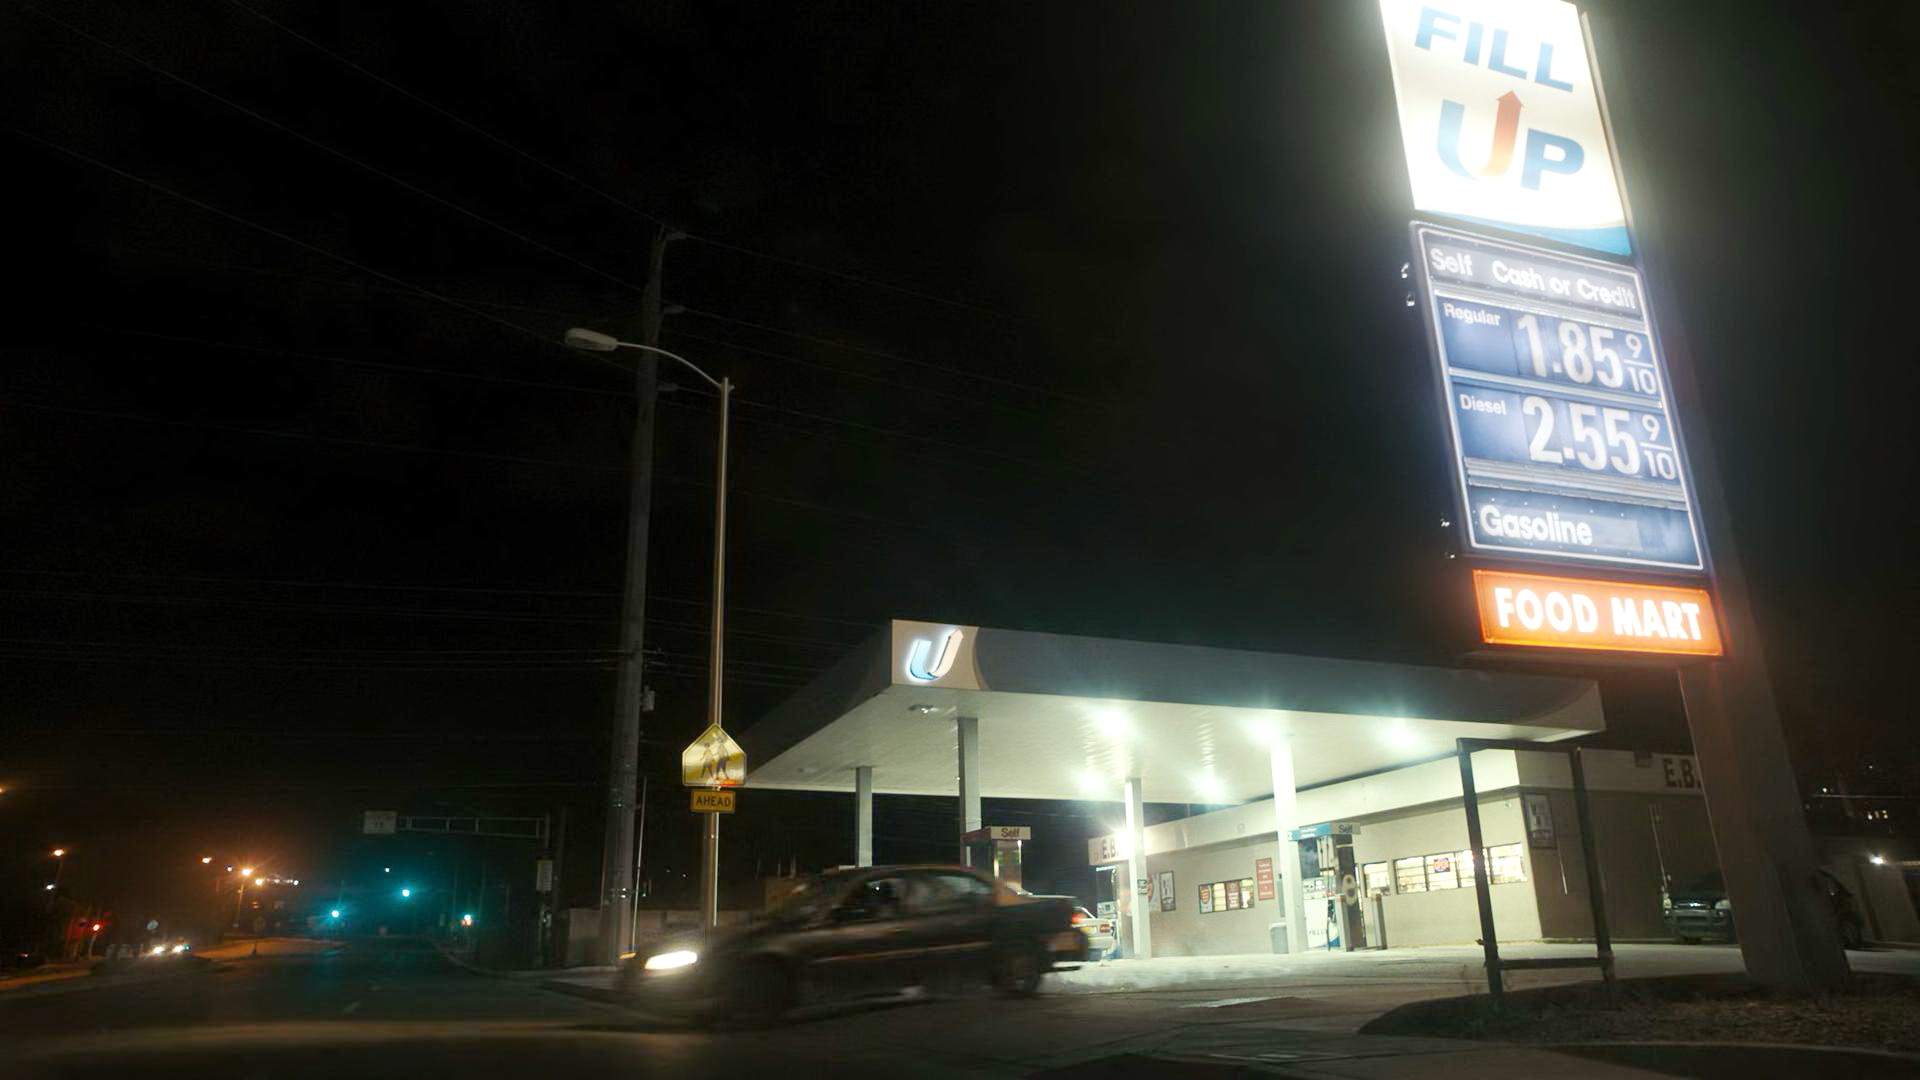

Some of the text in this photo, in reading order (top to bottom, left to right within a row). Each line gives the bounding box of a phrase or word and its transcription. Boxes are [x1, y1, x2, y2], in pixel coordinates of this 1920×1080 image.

[1414, 6, 1574, 92] FILL
[1437, 90, 1584, 191] UP
[1431, 249, 1637, 309] Self Cash or Credit
[1444, 303, 1641, 388] Regular 1.85 9
[1629, 367, 1657, 395] 10
[1460, 393, 1659, 475] Diesel 2.55 9
[1644, 450, 1676, 480] 10
[1480, 505, 1593, 546] Gasoline
[1495, 587, 1702, 640] FOOD MART
[695, 792, 731, 808] AHEAD
